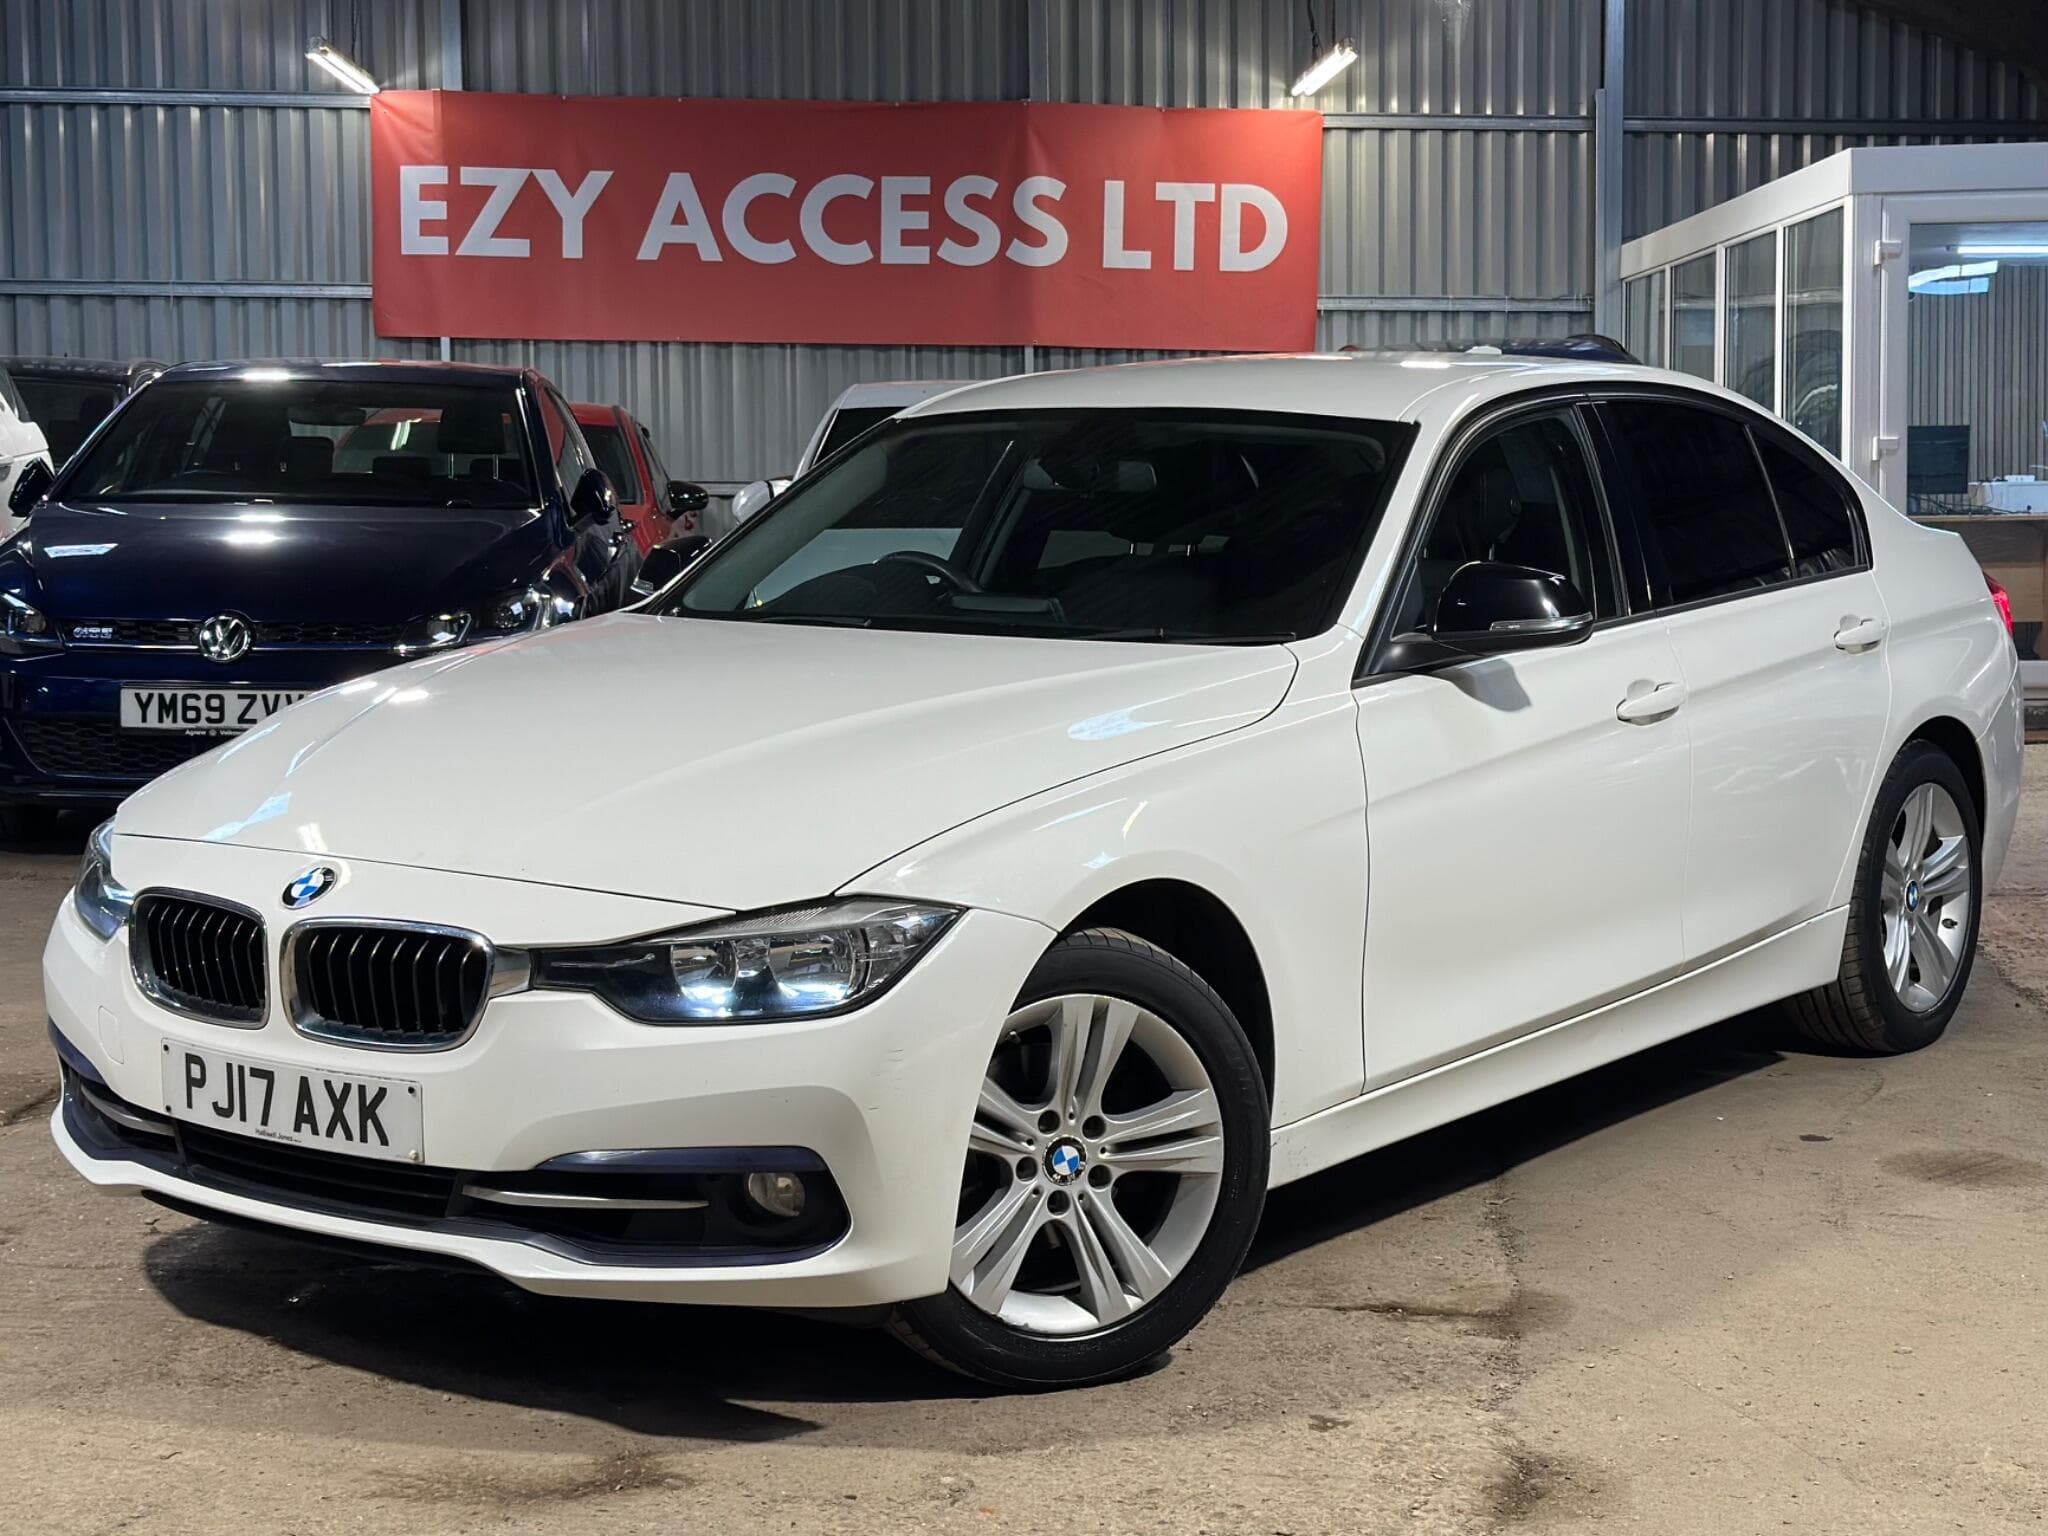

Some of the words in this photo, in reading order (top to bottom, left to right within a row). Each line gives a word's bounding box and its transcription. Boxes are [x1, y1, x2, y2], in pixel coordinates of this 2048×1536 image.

[400, 165, 613, 260] EZY
[637, 172, 1069, 266] ACCESS
[1103, 180, 1288, 272] LTD
[135, 692, 226, 724] YM69
[185, 1053, 275, 1127] PJ17
[294, 1076, 390, 1147] AXK
